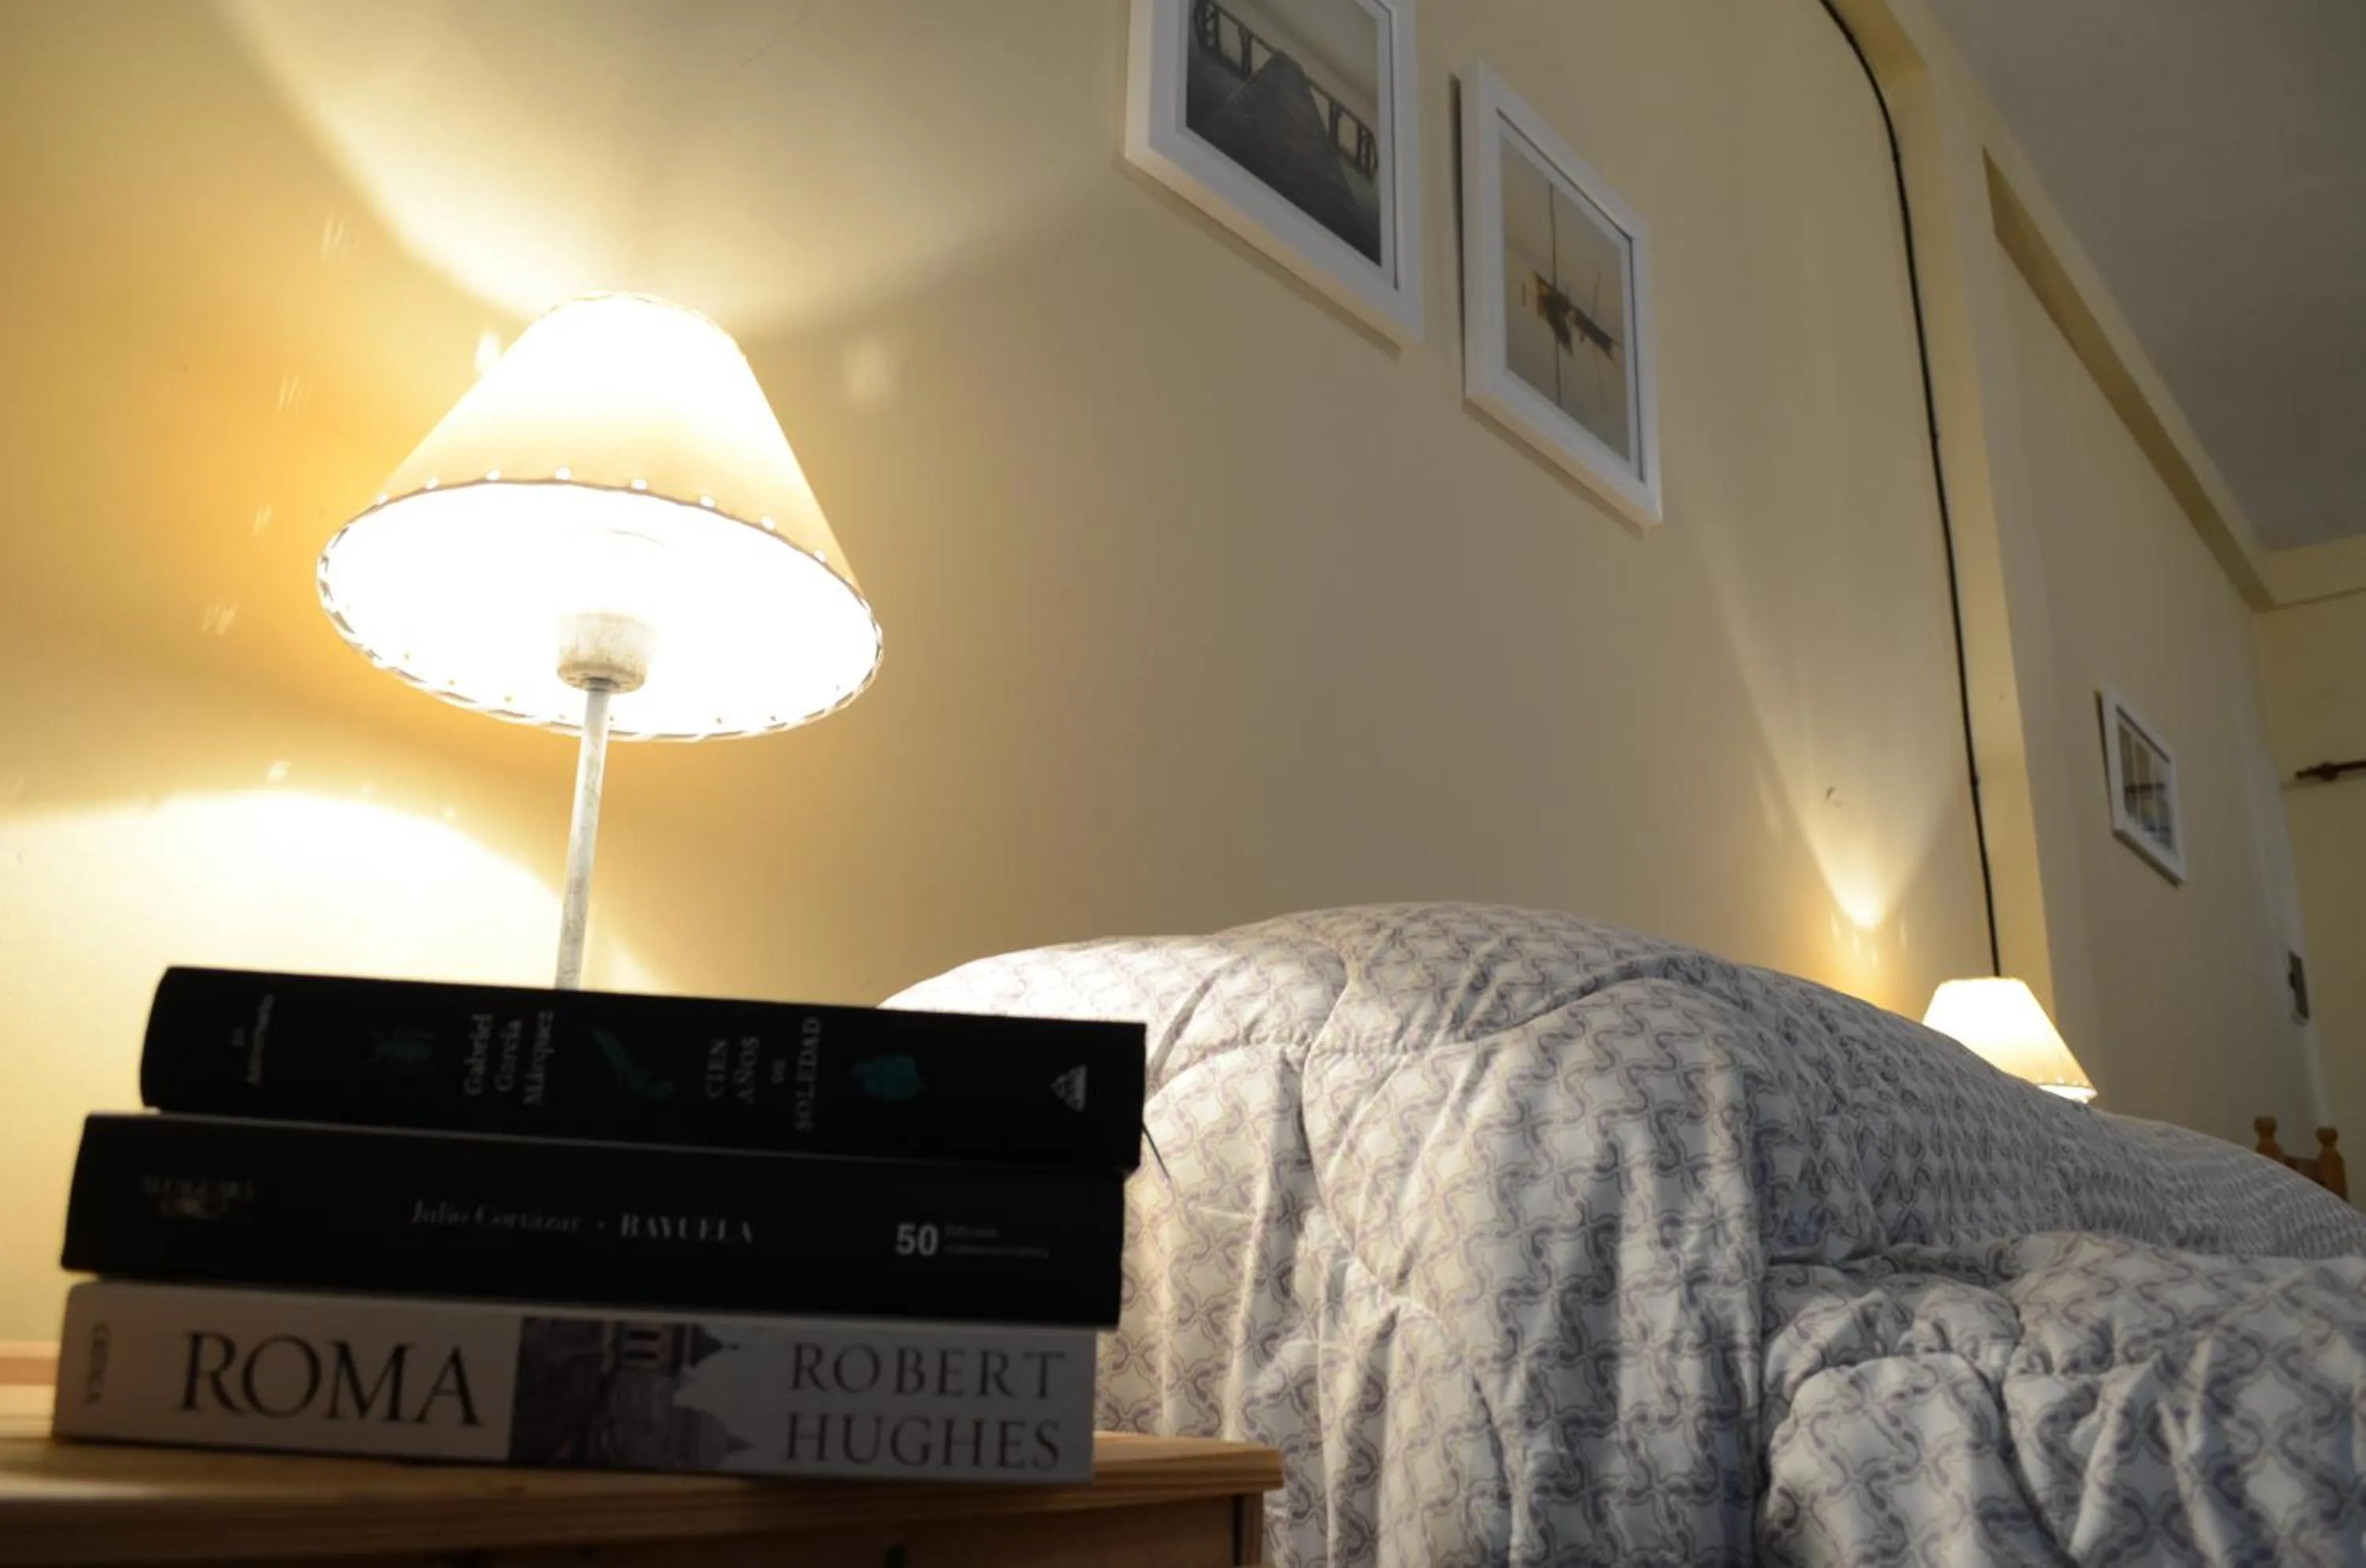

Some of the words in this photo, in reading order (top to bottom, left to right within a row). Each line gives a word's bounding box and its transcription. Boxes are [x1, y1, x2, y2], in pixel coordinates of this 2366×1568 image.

[463, 1013, 493, 1096] Gabriel
[704, 1037, 730, 1099] CIEN
[792, 1015, 823, 1133] SOLEDAD
[411, 1198, 470, 1226] Julio
[619, 1212, 753, 1244] RAYUELA
[894, 1222, 940, 1258] 50
[180, 1328, 483, 1426] ROMA
[789, 1342, 1065, 1400] ROBERT
[787, 1412, 1060, 1471] HUGHES
